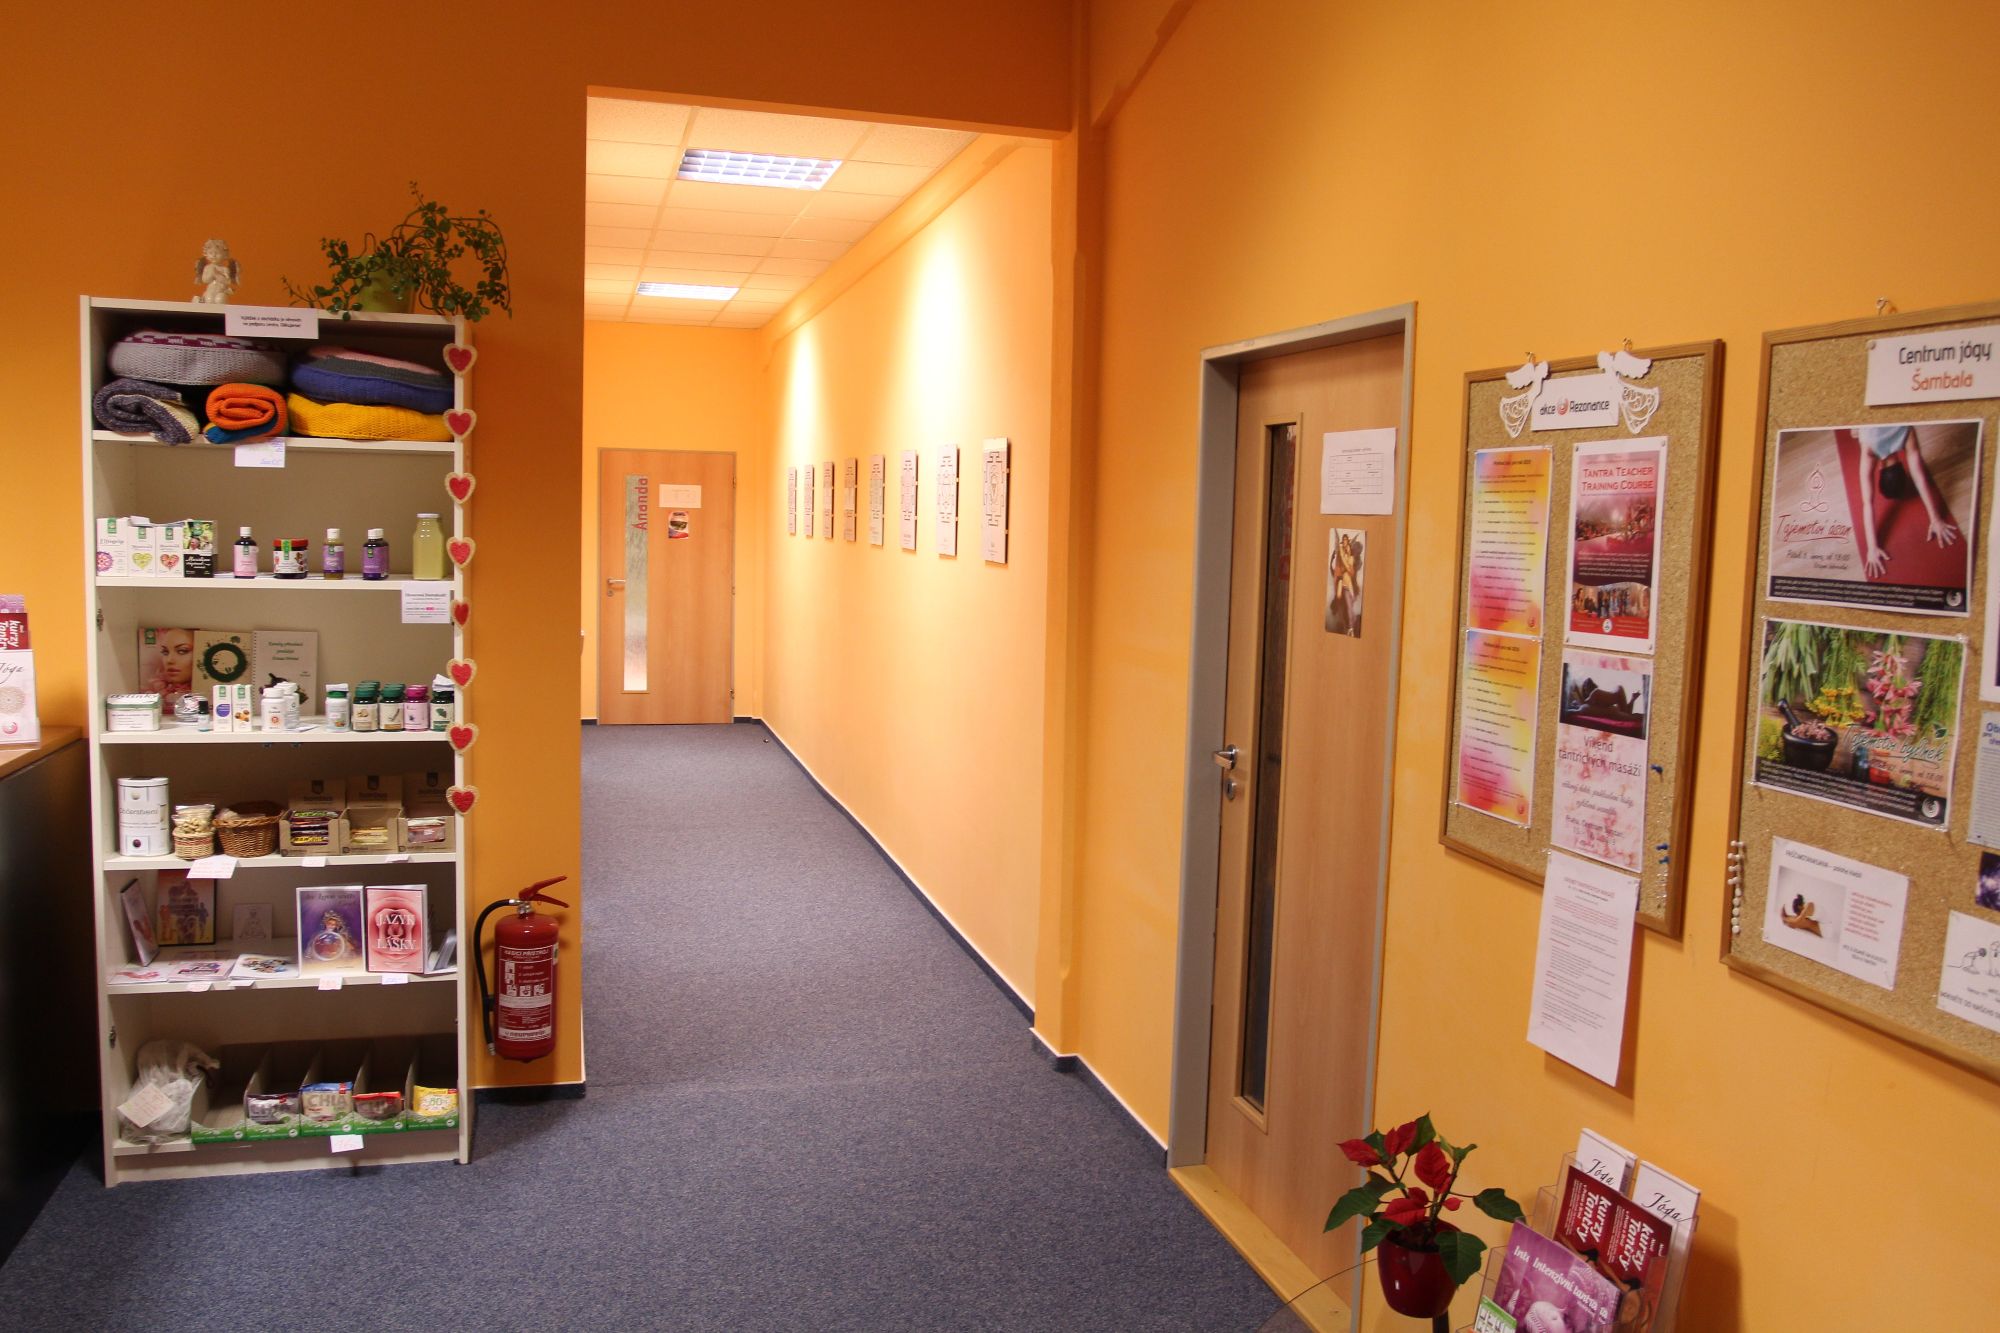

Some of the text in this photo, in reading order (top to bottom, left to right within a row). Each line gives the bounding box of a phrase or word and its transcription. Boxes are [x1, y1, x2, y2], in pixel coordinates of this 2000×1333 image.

[1899, 340, 1993, 365] Centrum jógy
[1911, 368, 1974, 392] Šambala
[1540, 400, 1610, 416] akce Rezonance
[1583, 466, 1654, 478] TANTRA TEACHER
[1581, 480, 1654, 491] TRAINING COURSE
[633, 477, 649, 531] Ananda
[7, 620, 22, 648] kurzy
[1583, 736, 1614, 753] Víkend
[1608, 760, 1642, 777] masáží
[377, 914, 416, 926] JAZYK
[307, 1094, 347, 1107] CHIA
[1587, 1158, 1616, 1186] Jóga
[1576, 1191, 1600, 1243] Tantry
[1591, 1196, 1612, 1243] kurzy
[1641, 1192, 1688, 1223] Jóga
[1618, 1218, 1642, 1271] Tantry
[1632, 1223, 1654, 1272] kurzy
